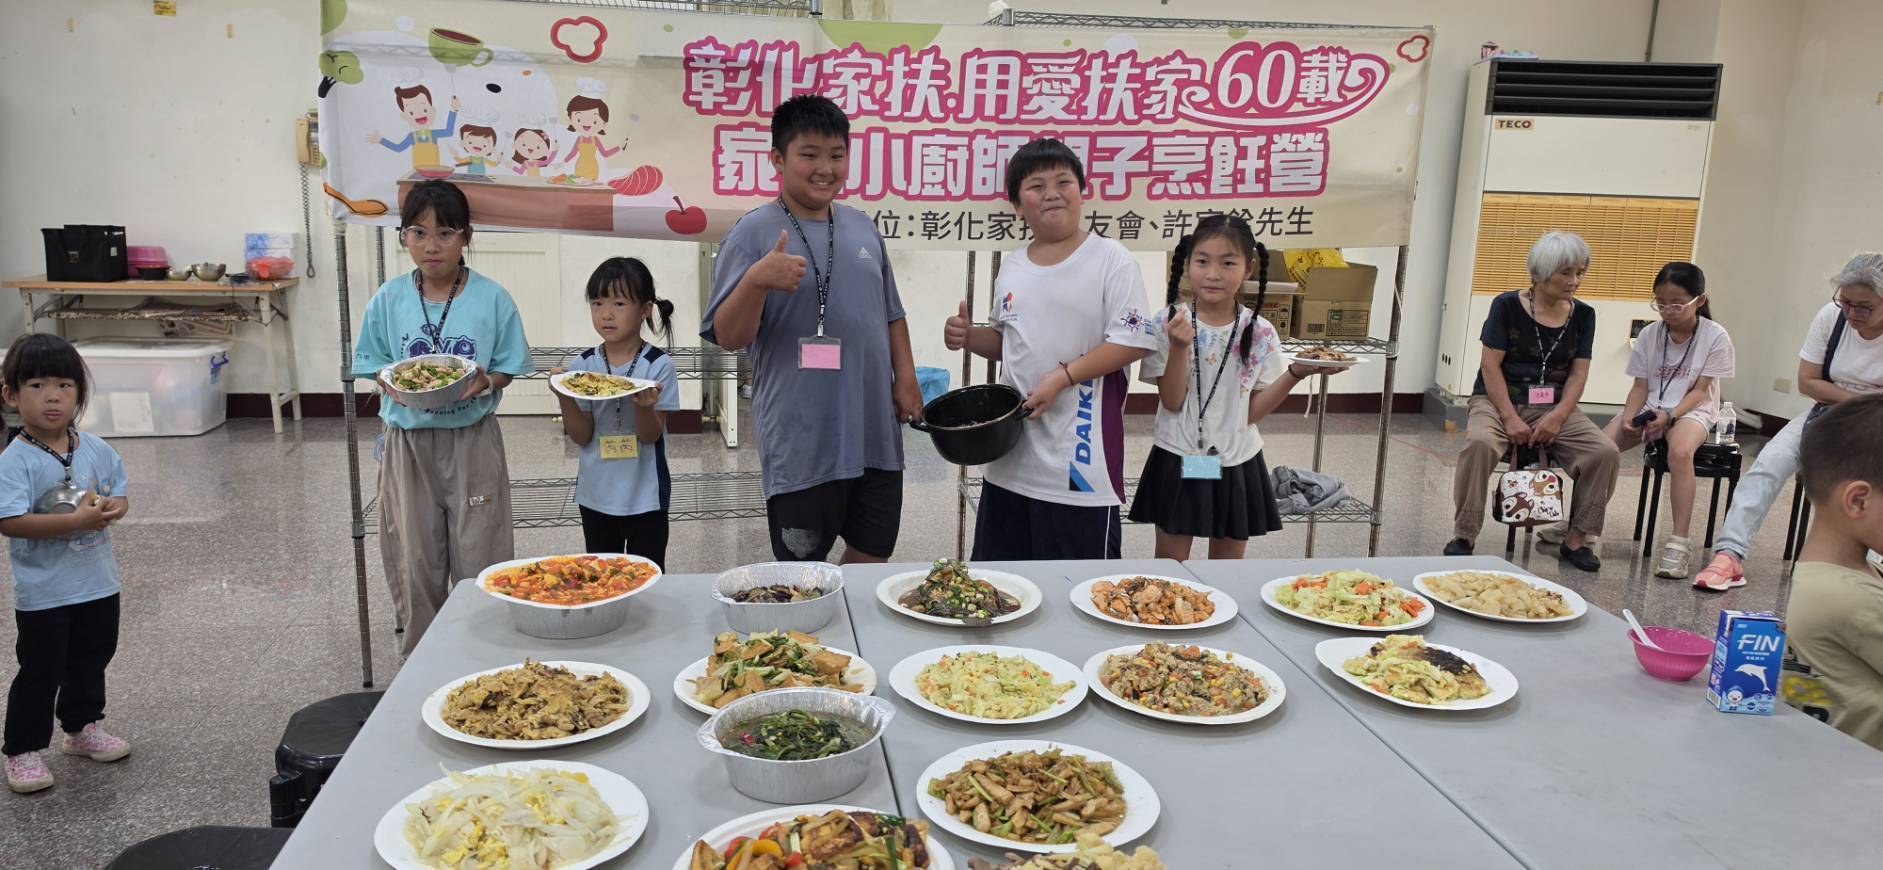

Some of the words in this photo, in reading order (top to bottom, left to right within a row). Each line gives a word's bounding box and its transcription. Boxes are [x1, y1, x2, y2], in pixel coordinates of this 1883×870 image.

[1498, 120, 1532, 129] TECO
[718, 128, 1325, 196] 家小廚師子烹飪營
[1737, 634, 1780, 652] FIN
